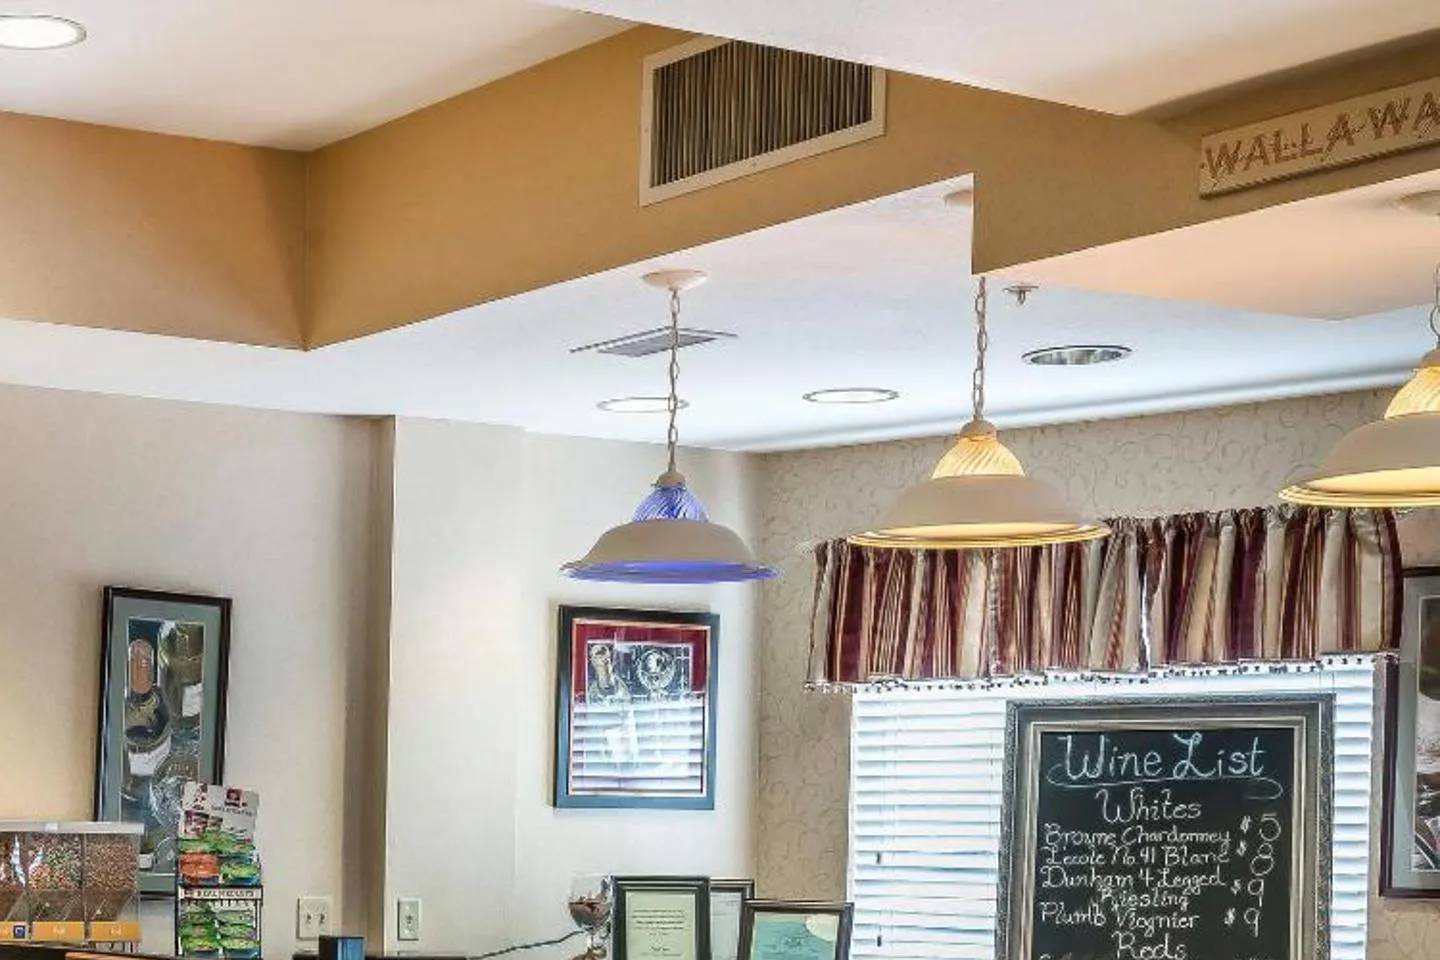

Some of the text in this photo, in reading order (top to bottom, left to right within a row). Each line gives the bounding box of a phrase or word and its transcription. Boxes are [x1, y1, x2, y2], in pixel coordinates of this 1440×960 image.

[1203, 112, 1355, 178] WALLA
[1057, 732, 1266, 780] Wine List
[1094, 787, 1203, 823] Whites
[1111, 931, 1187, 960] Reds
